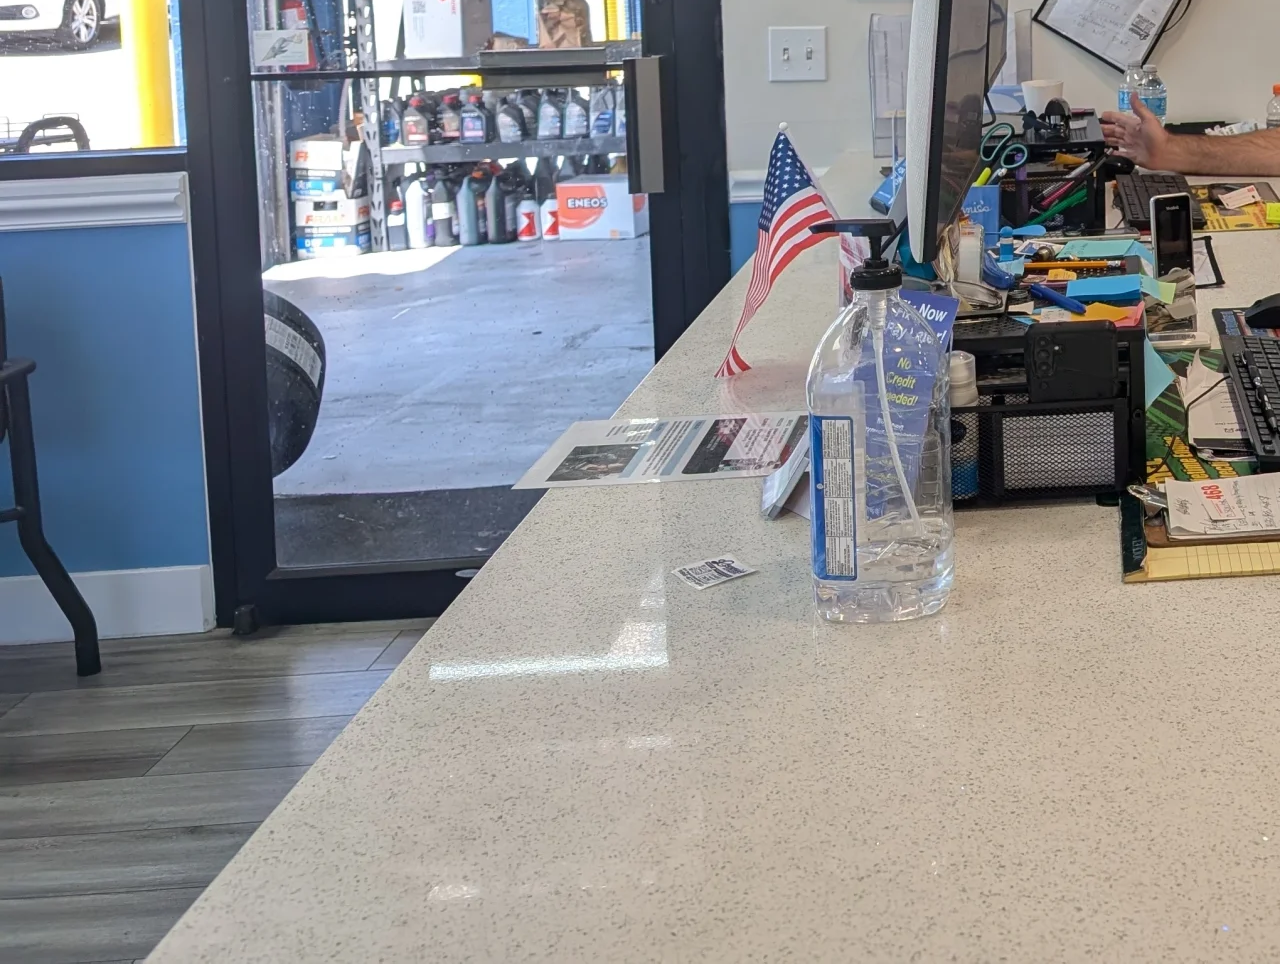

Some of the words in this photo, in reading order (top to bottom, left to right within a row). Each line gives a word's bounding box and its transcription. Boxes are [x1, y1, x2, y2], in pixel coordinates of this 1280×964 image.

[568, 198, 608, 208] ENEOS
[920, 303, 948, 322] Now
[897, 357, 912, 370] No
[886, 372, 916, 388] Credit
[1201, 484, 1224, 500] 468
